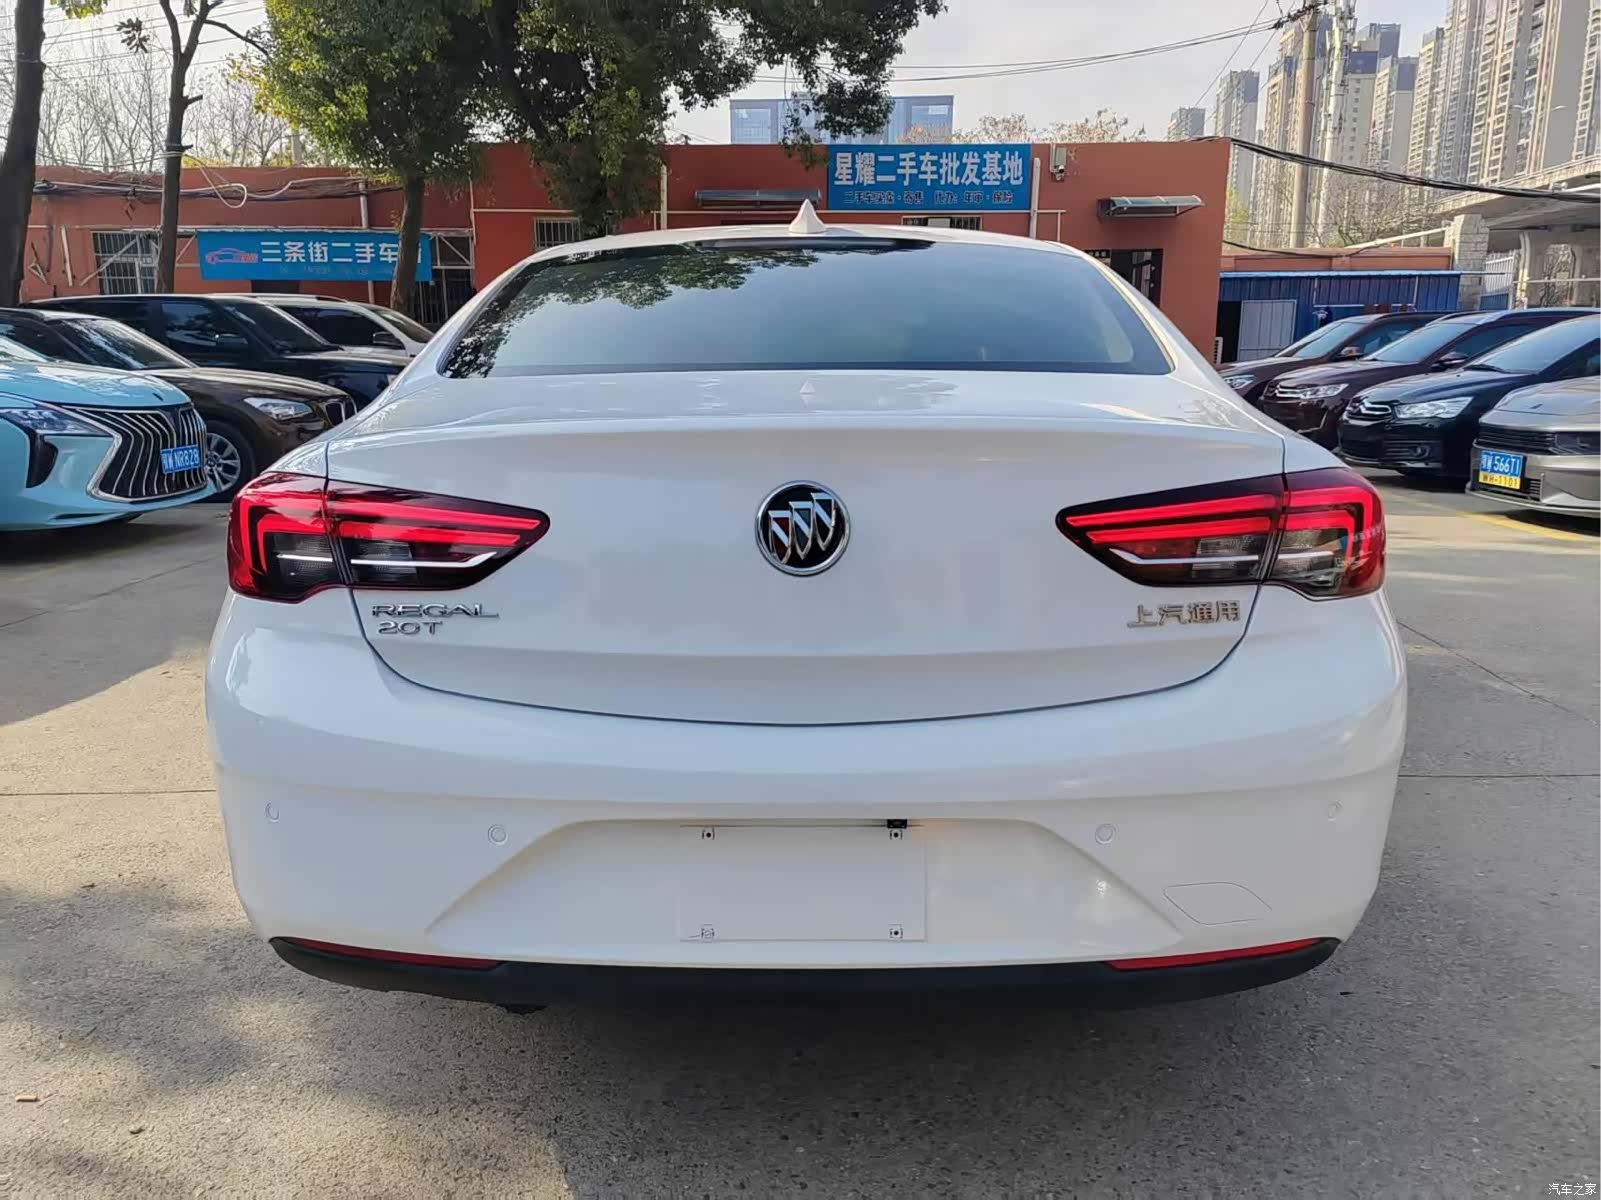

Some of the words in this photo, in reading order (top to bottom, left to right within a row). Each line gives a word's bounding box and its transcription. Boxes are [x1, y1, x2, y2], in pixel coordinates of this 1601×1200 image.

[834, 151, 1024, 186] 星耀二手车批发基地
[260, 241, 422, 264] 三条街二手车
[372, 603, 499, 618] REGAL
[1127, 600, 1240, 628] 上汽通用
[378, 620, 443, 636] 20T
